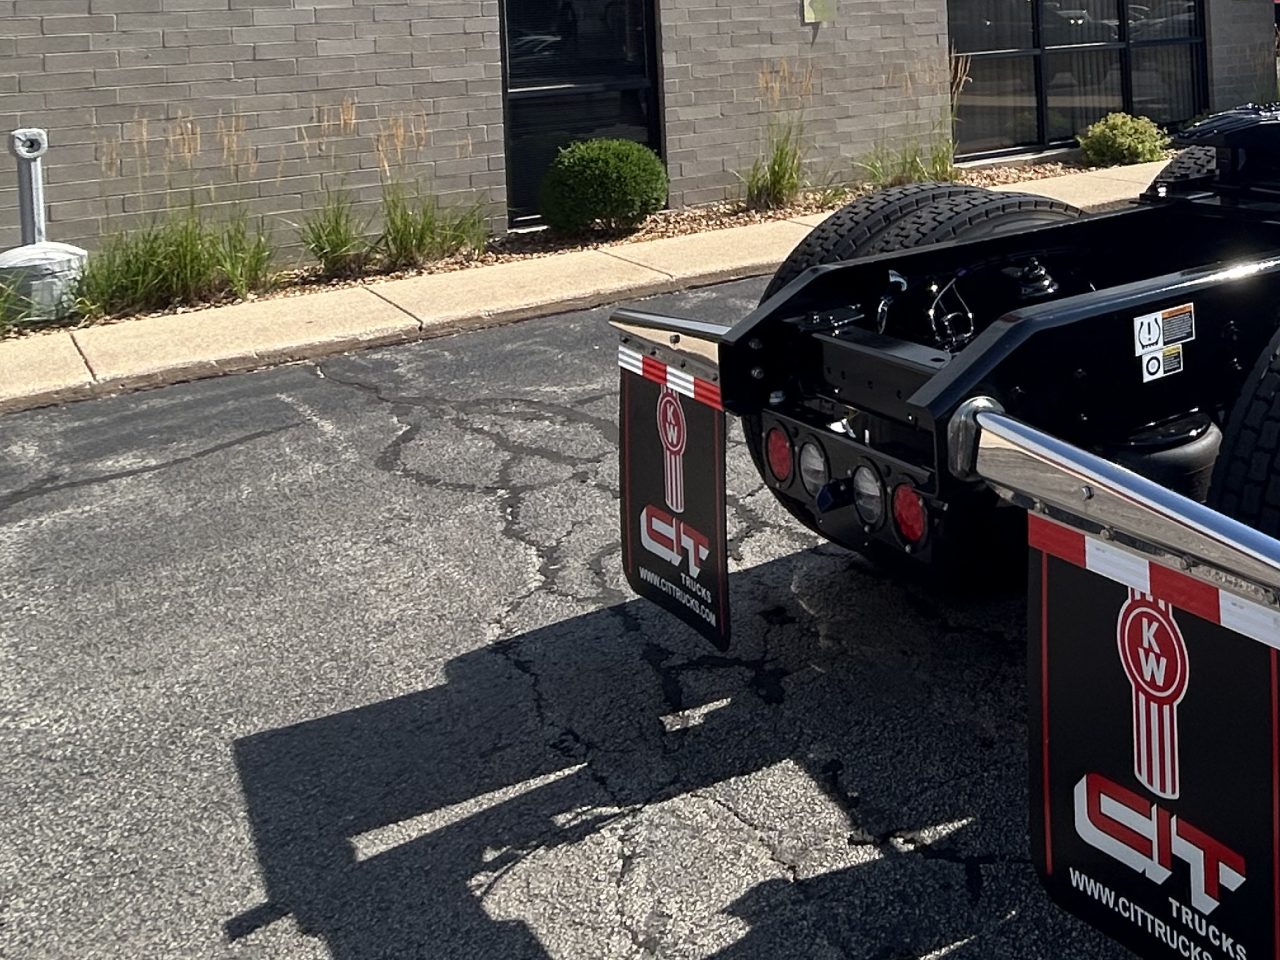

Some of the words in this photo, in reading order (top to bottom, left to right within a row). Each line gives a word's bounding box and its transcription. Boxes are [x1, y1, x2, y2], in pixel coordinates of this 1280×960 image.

[640, 504, 710, 578] CIT
[639, 566, 717, 628] WWW.CITTRUCKS.COM
[680, 572, 712, 604] TRUCKS
[1074, 772, 1247, 916] CIT
[1168, 896, 1248, 960] TRUCKS
